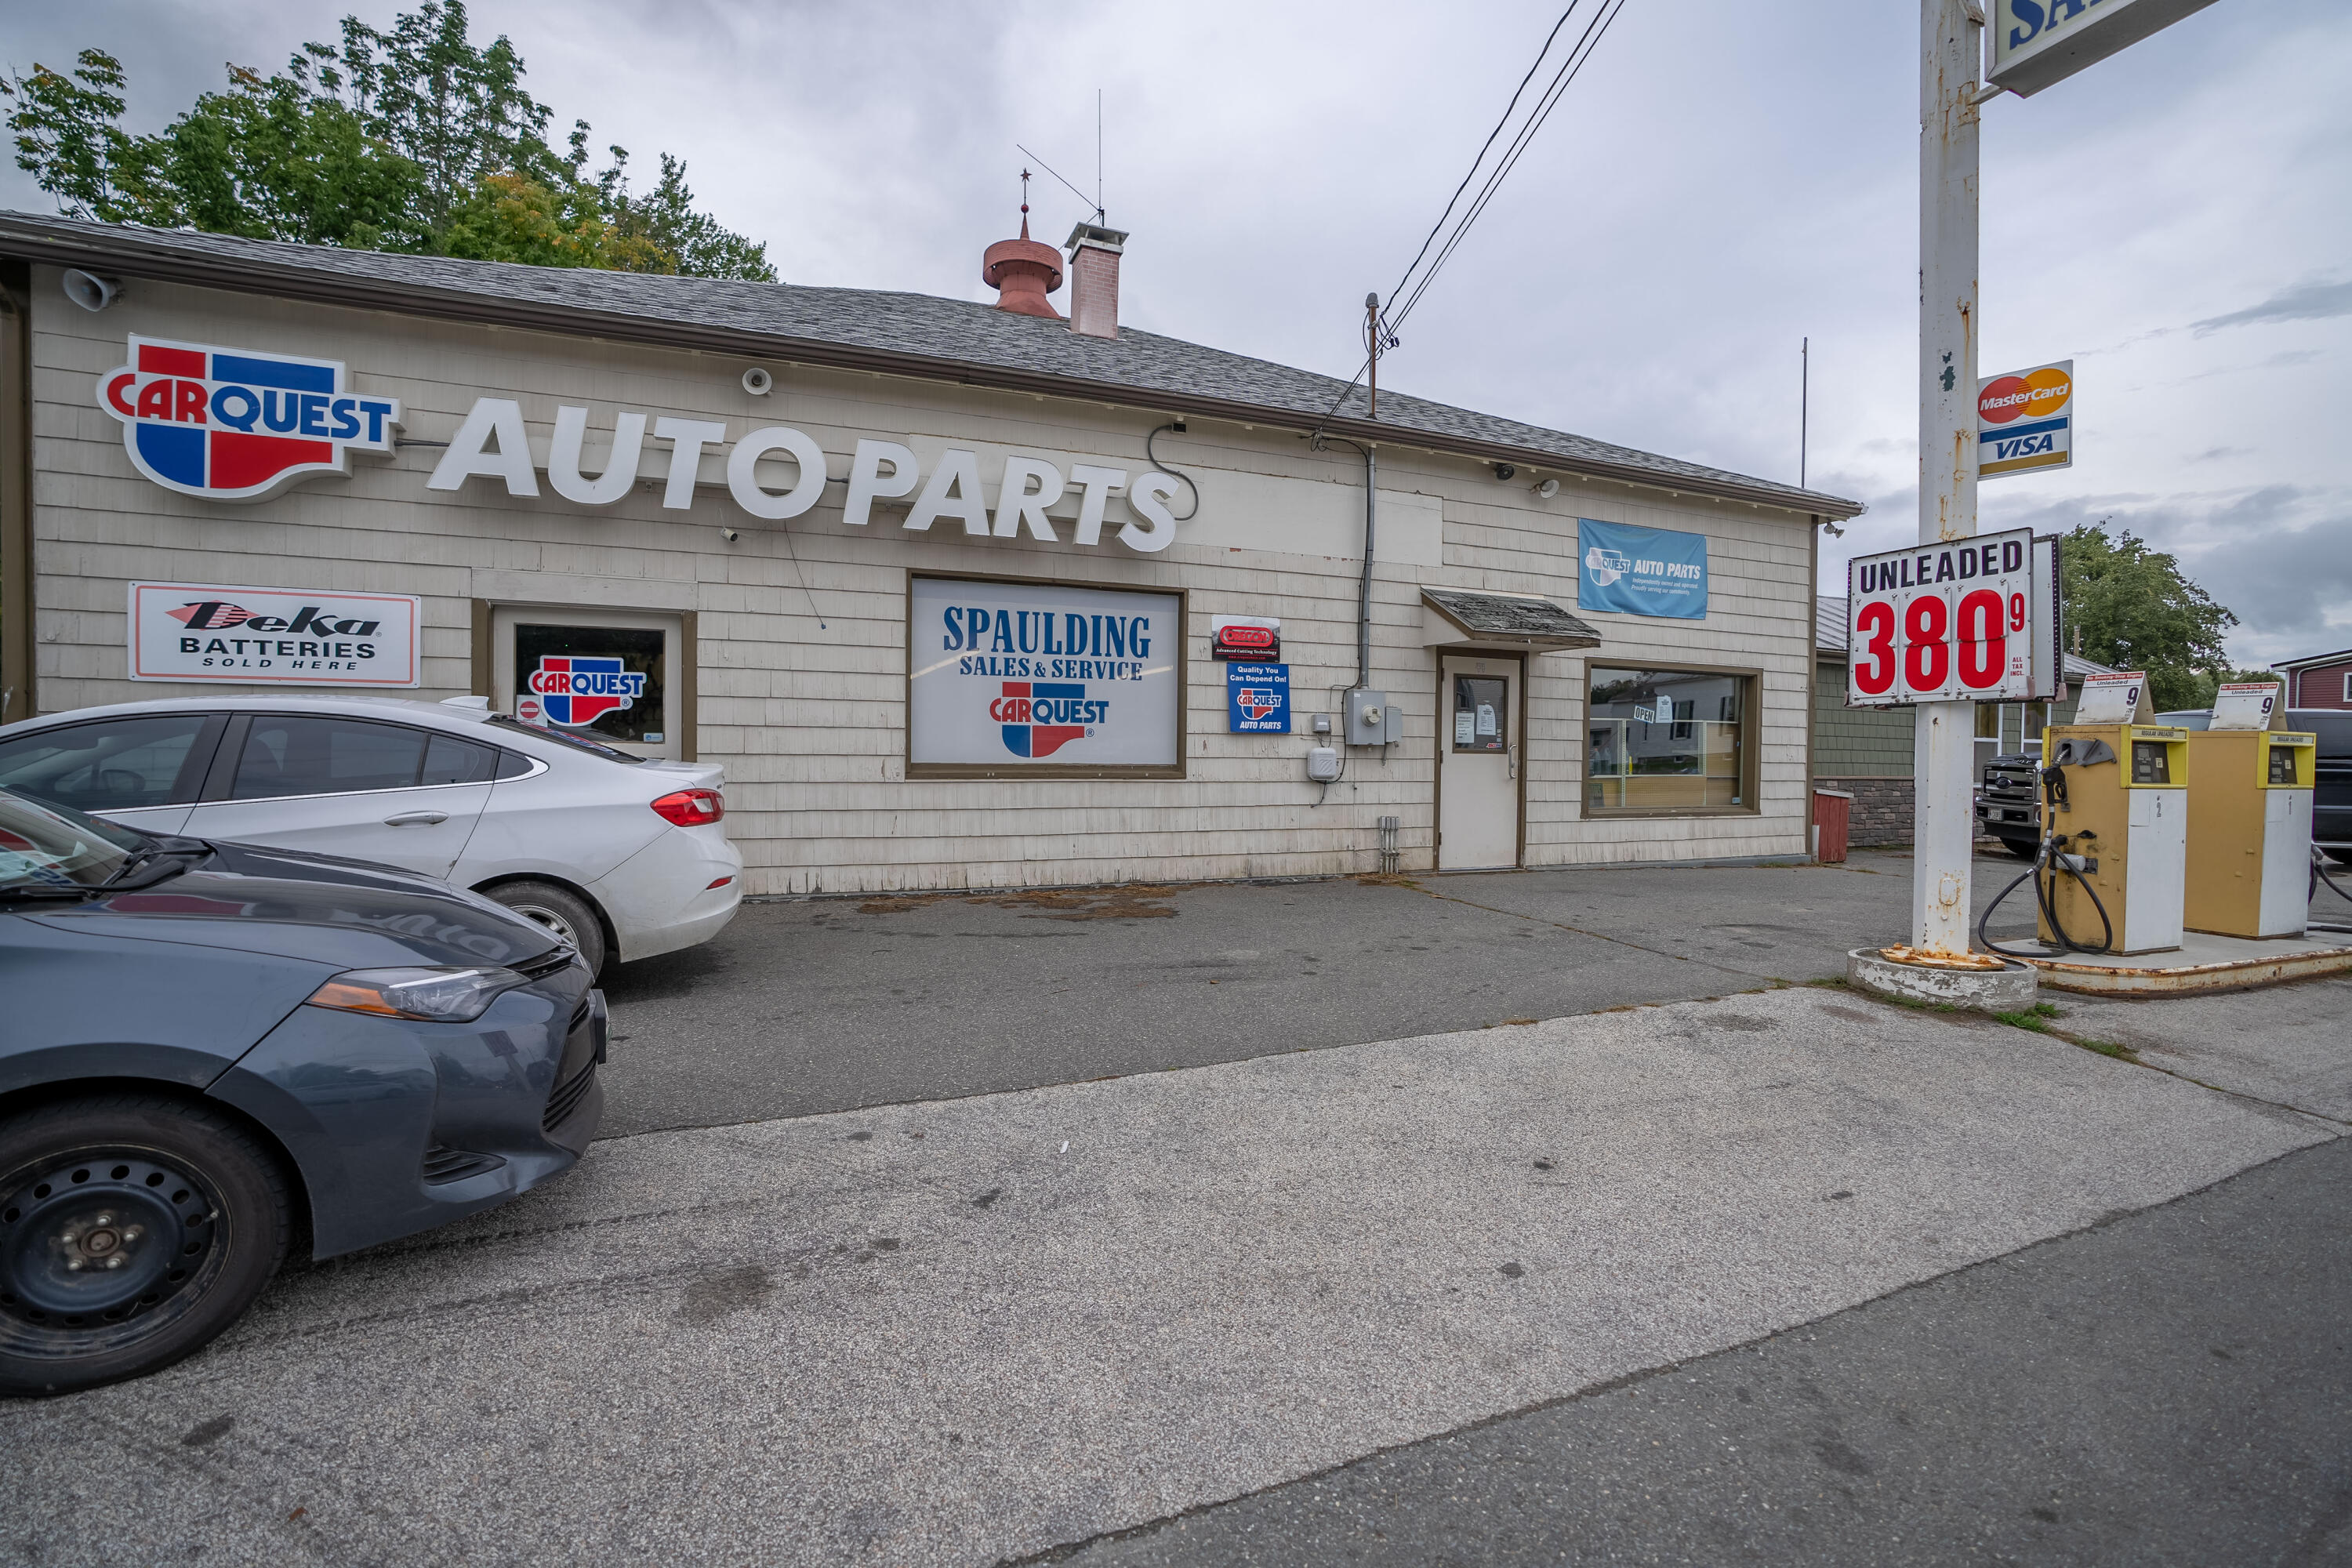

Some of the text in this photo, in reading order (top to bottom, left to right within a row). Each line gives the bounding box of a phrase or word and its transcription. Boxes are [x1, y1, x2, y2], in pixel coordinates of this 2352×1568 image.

[107, 373, 392, 443] CARQUEST
[1980, 383, 2069, 411] MasterCard
[1995, 434, 2053, 459] VISA
[424, 397, 1180, 554] AUTO PARTS
[1634, 559, 1701, 580] AUTO PARTS
[1860, 540, 2022, 593] UNLEADED
[1631, 584, 1646, 593] Proudly
[1632, 576, 1664, 586] Independently
[181, 601, 381, 638] Deka
[943, 606, 1152, 659] SPAULDING
[1225, 630, 1268, 643] OREGON
[1855, 589, 2025, 695] 380 9
[180, 637, 376, 659] BATTERIES
[202, 657, 358, 670] SOLD HERE
[960, 655, 1143, 681] SALES & SERVICE
[1237, 666, 1264, 674] Quality
[532, 672, 644, 695] CARQUEST
[1238, 695, 1281, 706] CARQUEST
[2126, 687, 2139, 706] 9
[2261, 697, 2274, 714] 9
[989, 698, 1109, 724] CARQUEST
[1635, 707, 1653, 722] OPEN
[1259, 721, 1282, 730] PARTS
